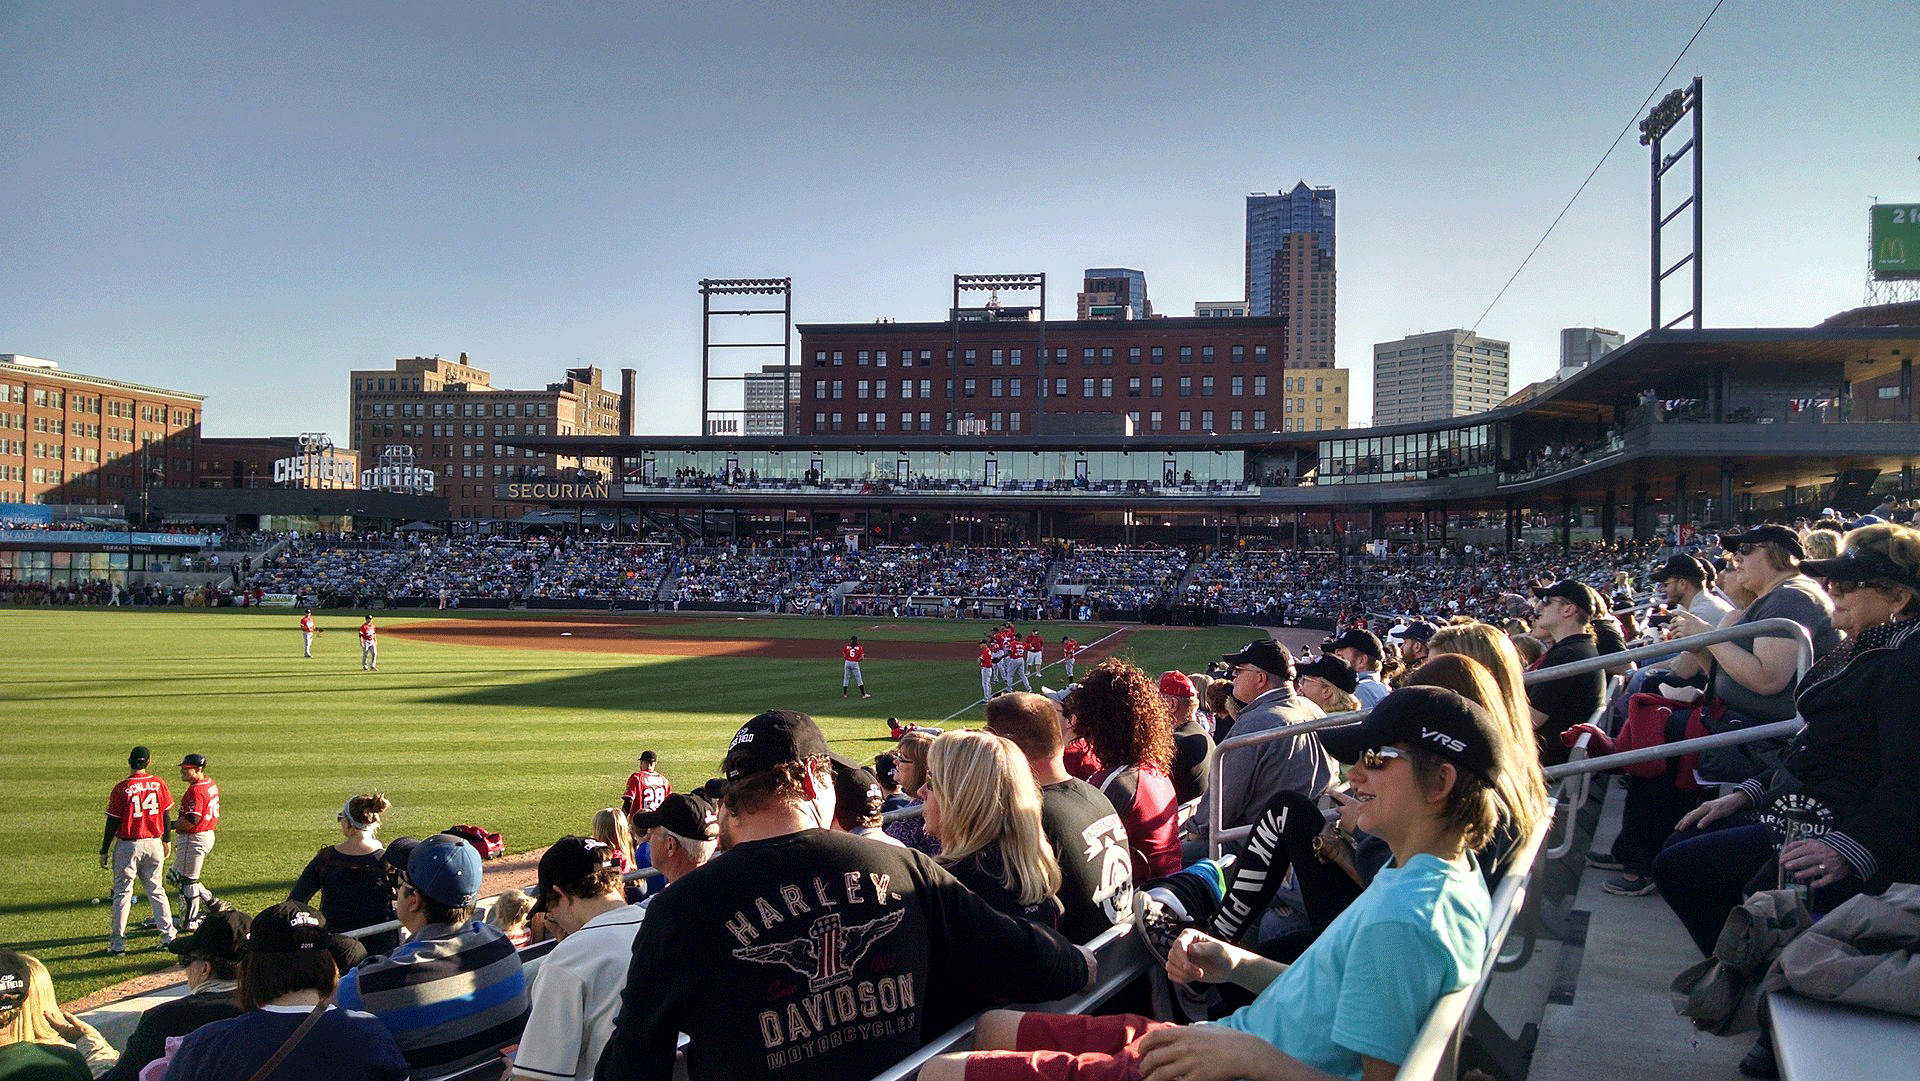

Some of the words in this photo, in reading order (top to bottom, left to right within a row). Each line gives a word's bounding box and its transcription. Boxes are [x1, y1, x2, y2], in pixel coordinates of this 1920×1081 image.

[1893, 208, 1905, 224] 2
[1909, 208, 1920, 224] f
[274, 456, 305, 483] CHS
[508, 483, 609, 499] SECURIAN
[150, 535, 201, 544] TICASINO.COM
[738, 733, 754, 744] FIELD
[1422, 726, 1468, 752] VRS
[131, 792, 160, 819] 14
[643, 786, 666, 812] 28
[1247, 806, 1289, 867] PINK
[1214, 892, 1252, 943] PIN
[758, 972, 916, 1049] DAVIDSON
[766, 1012, 916, 1071] MOTORCYCLES
